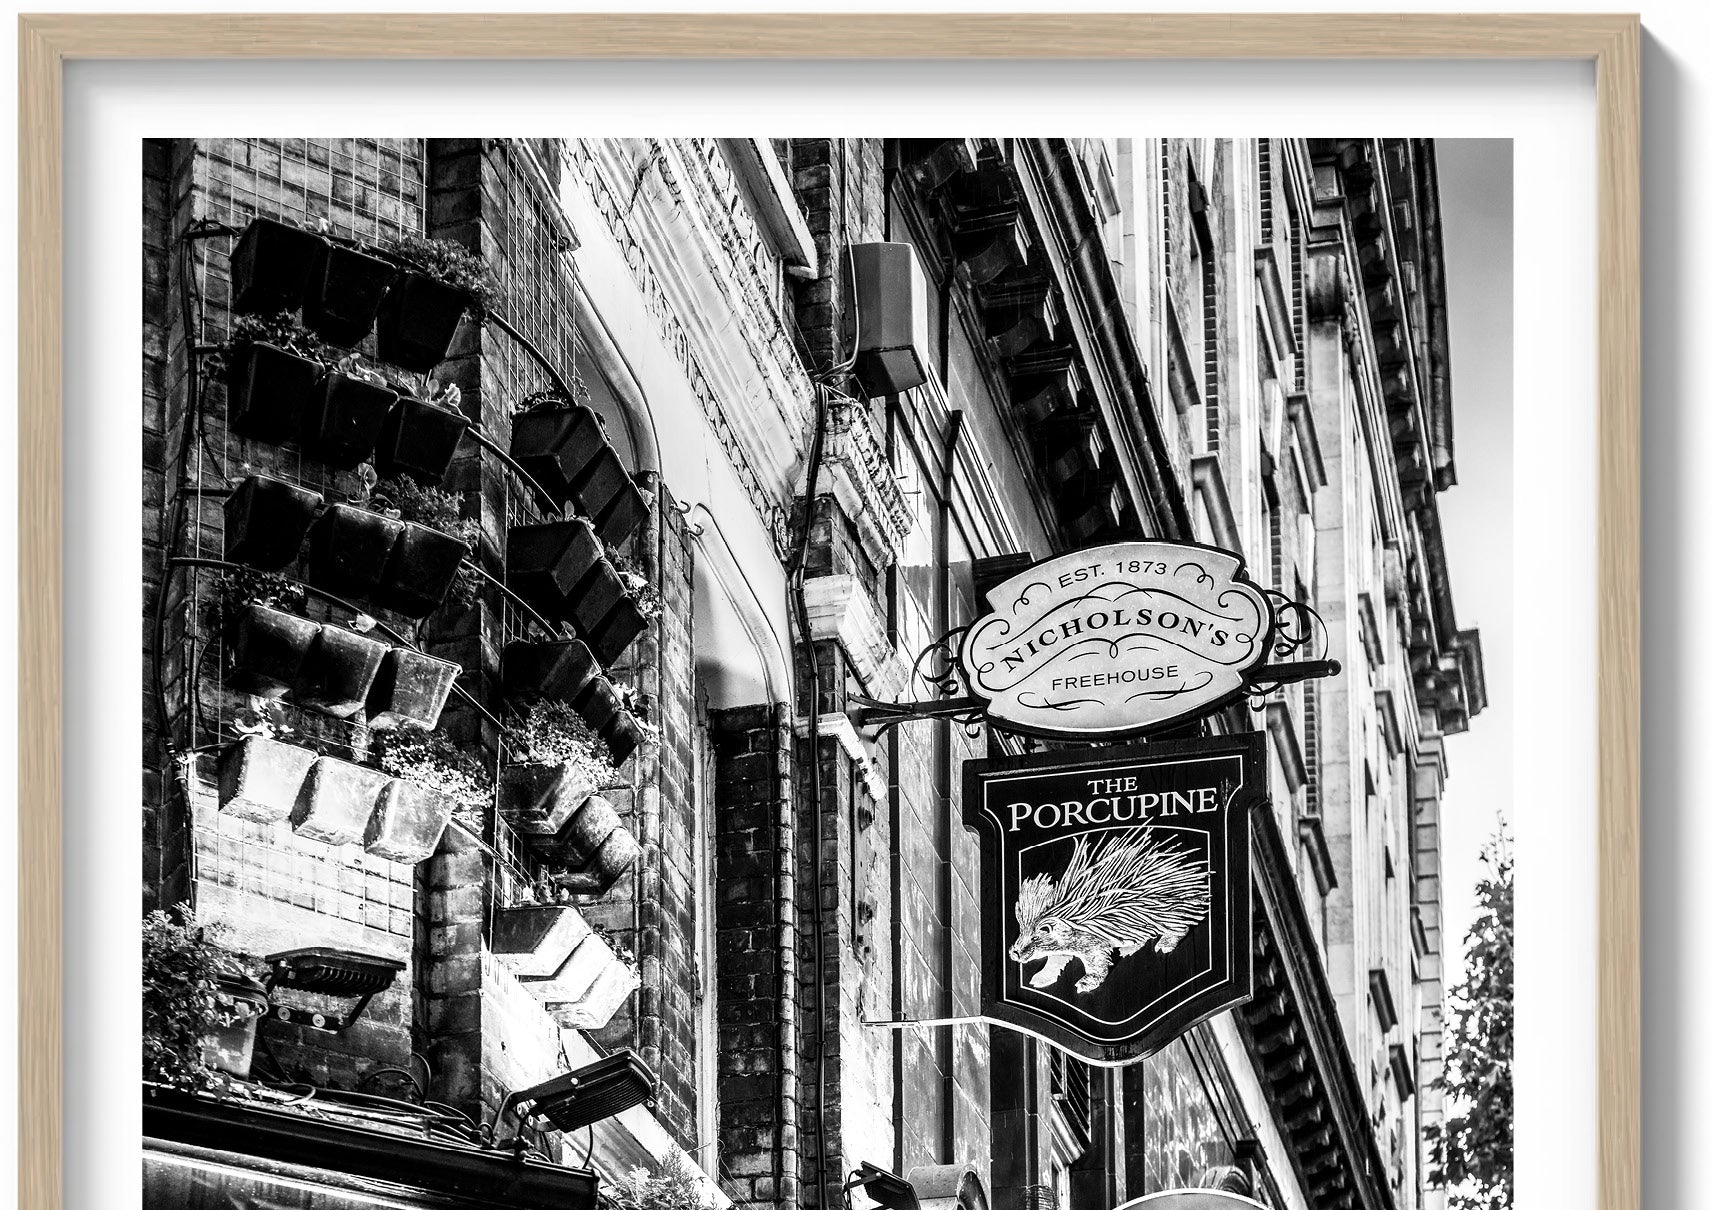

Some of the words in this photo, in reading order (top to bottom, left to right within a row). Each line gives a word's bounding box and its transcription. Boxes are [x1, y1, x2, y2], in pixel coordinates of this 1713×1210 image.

[1058, 563, 1105, 588] EST.
[1115, 560, 1168, 576] 1873
[1002, 608, 1230, 673] NICHOLSON'S
[1051, 664, 1180, 691] FREEHOUSE
[1087, 776, 1139, 796] THE
[1007, 787, 1219, 832] PORCUPINE
